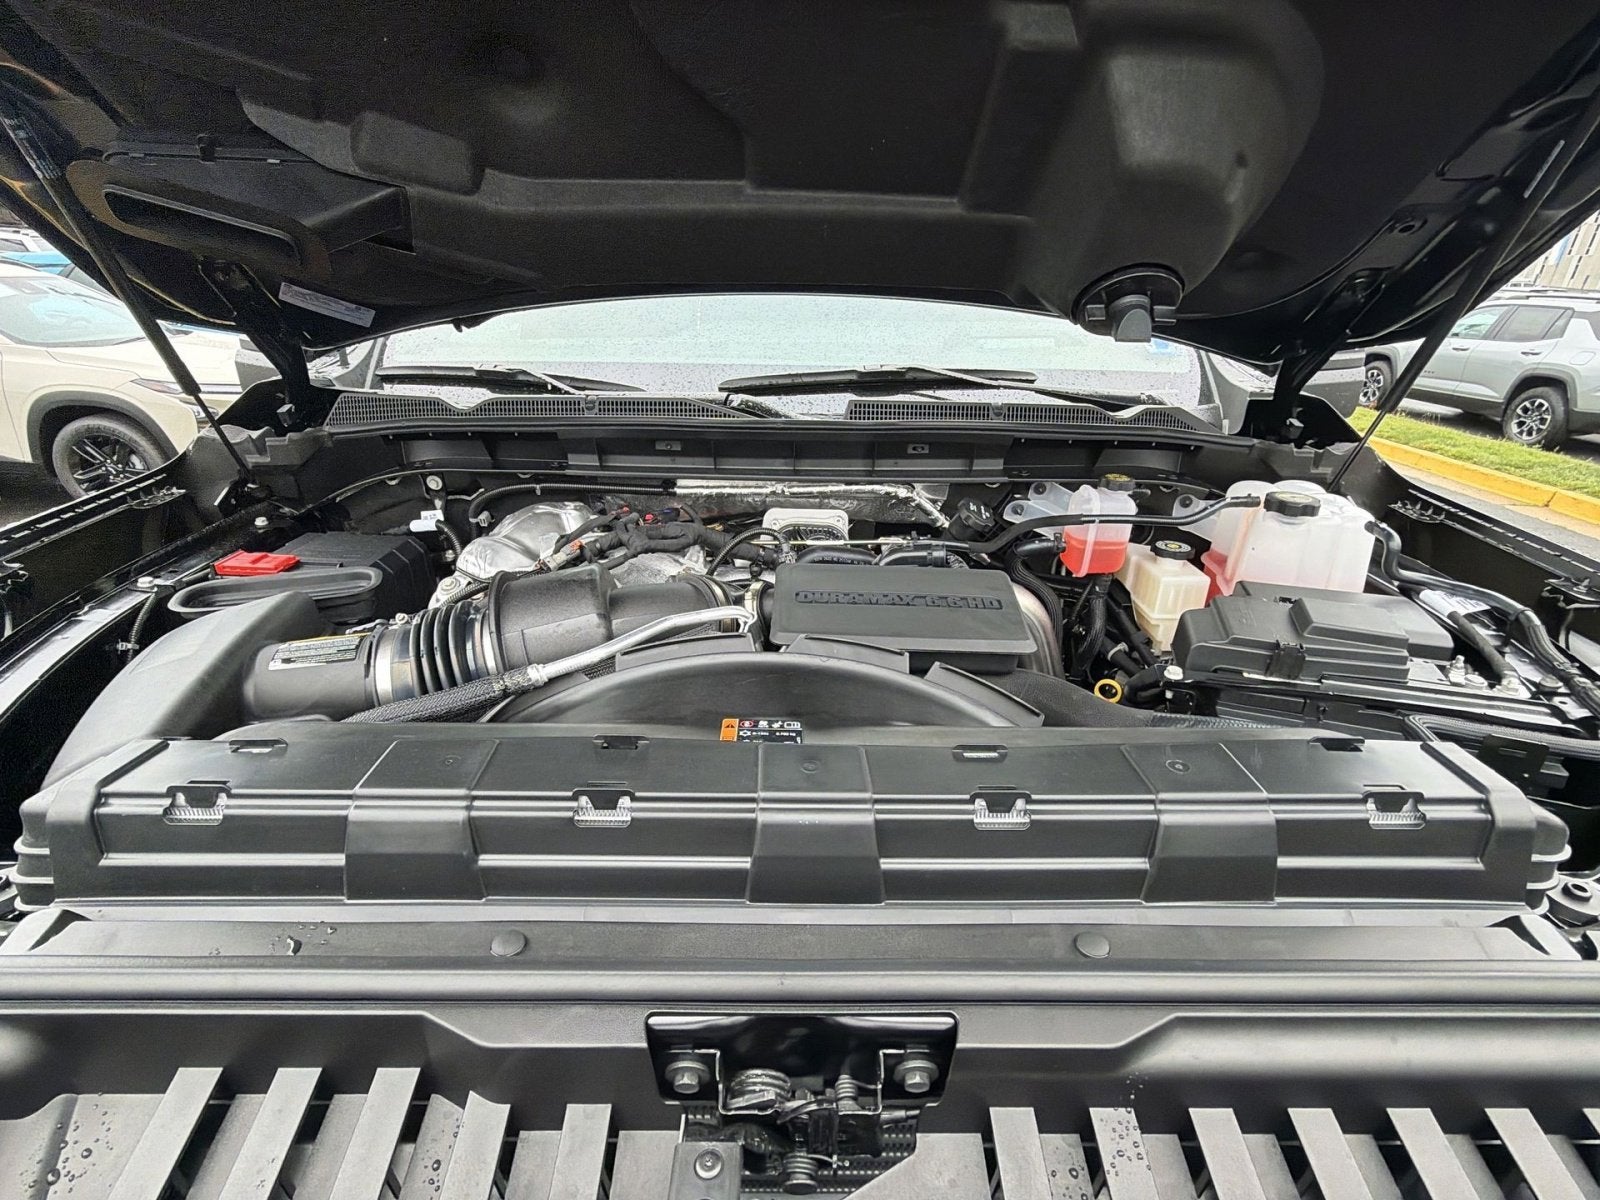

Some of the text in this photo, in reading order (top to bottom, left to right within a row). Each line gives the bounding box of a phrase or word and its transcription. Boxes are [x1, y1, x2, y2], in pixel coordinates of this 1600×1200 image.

[795, 590, 1003, 610] DURAMAX 6.6 HD
